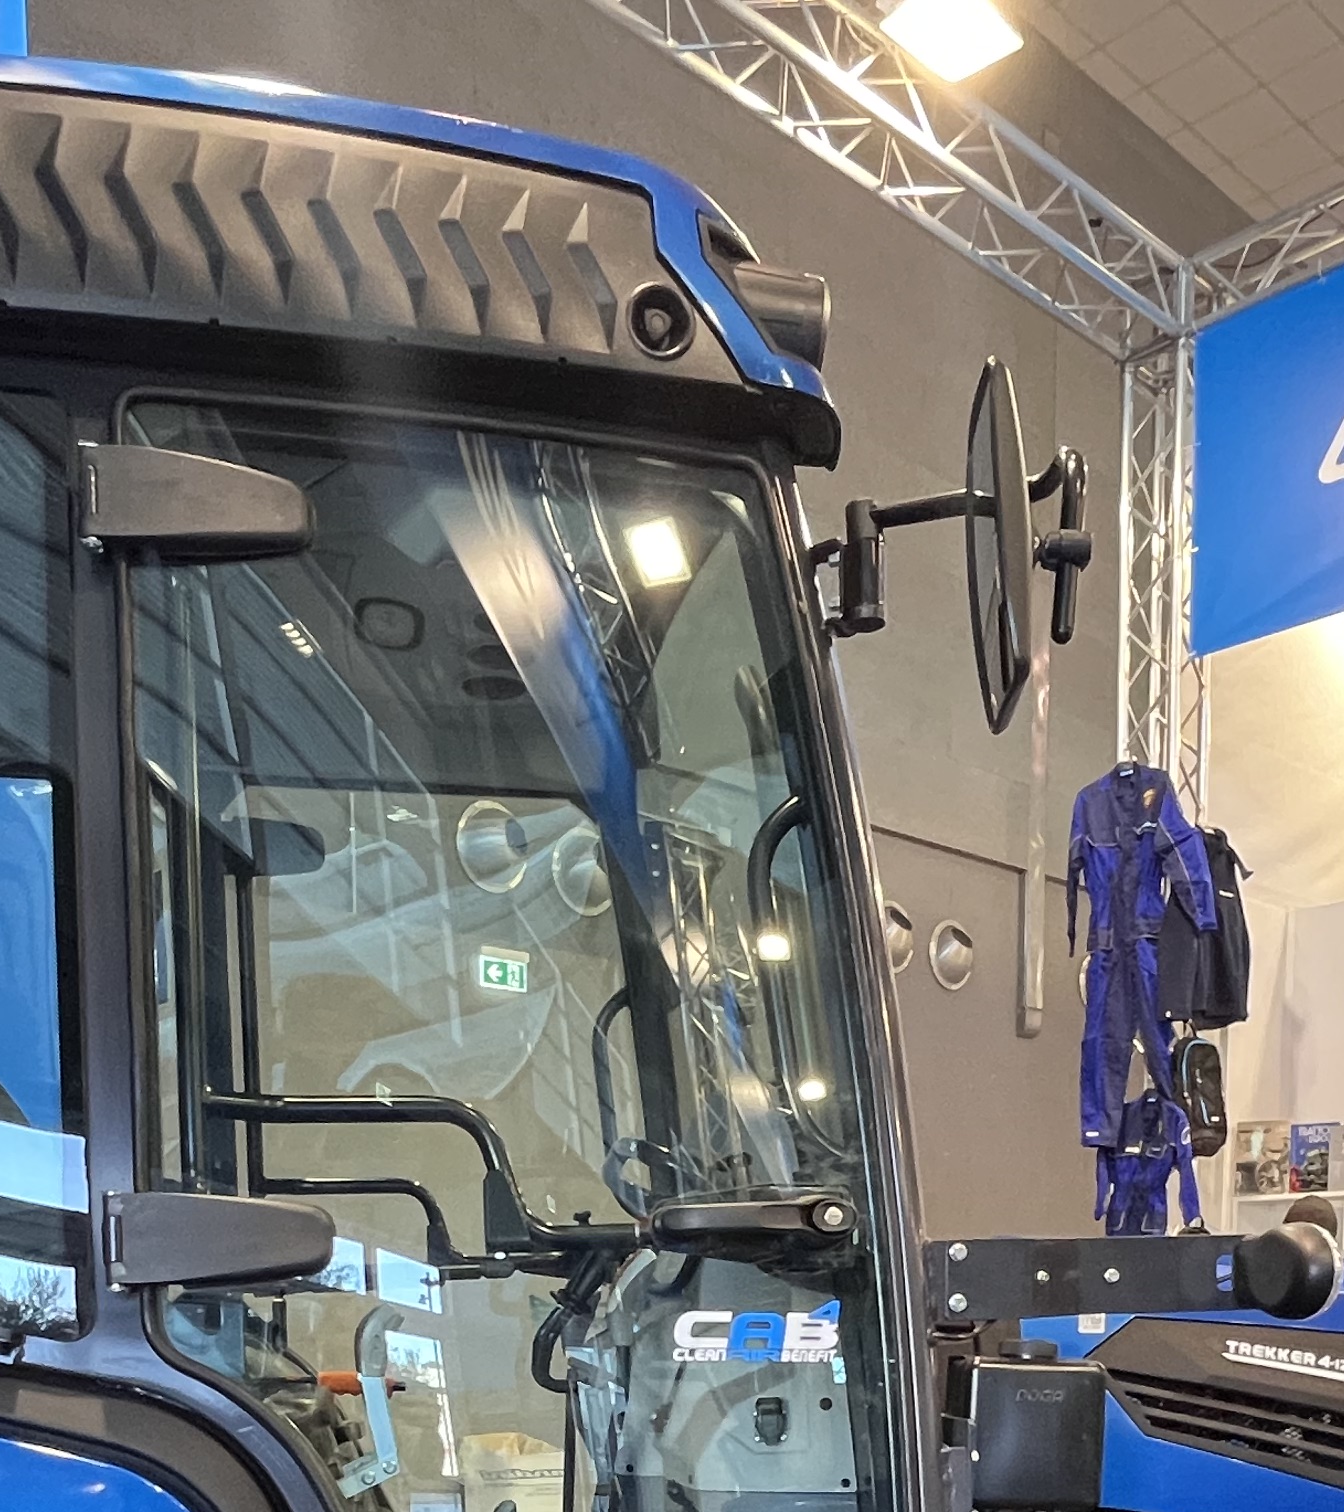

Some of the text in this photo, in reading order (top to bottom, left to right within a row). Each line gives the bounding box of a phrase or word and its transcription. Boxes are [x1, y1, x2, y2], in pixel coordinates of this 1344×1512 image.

[672, 1347, 727, 1362] CLEAN
[781, 1349, 838, 1363] BENEFIT
[1225, 1339, 1317, 1368] TREKKER
